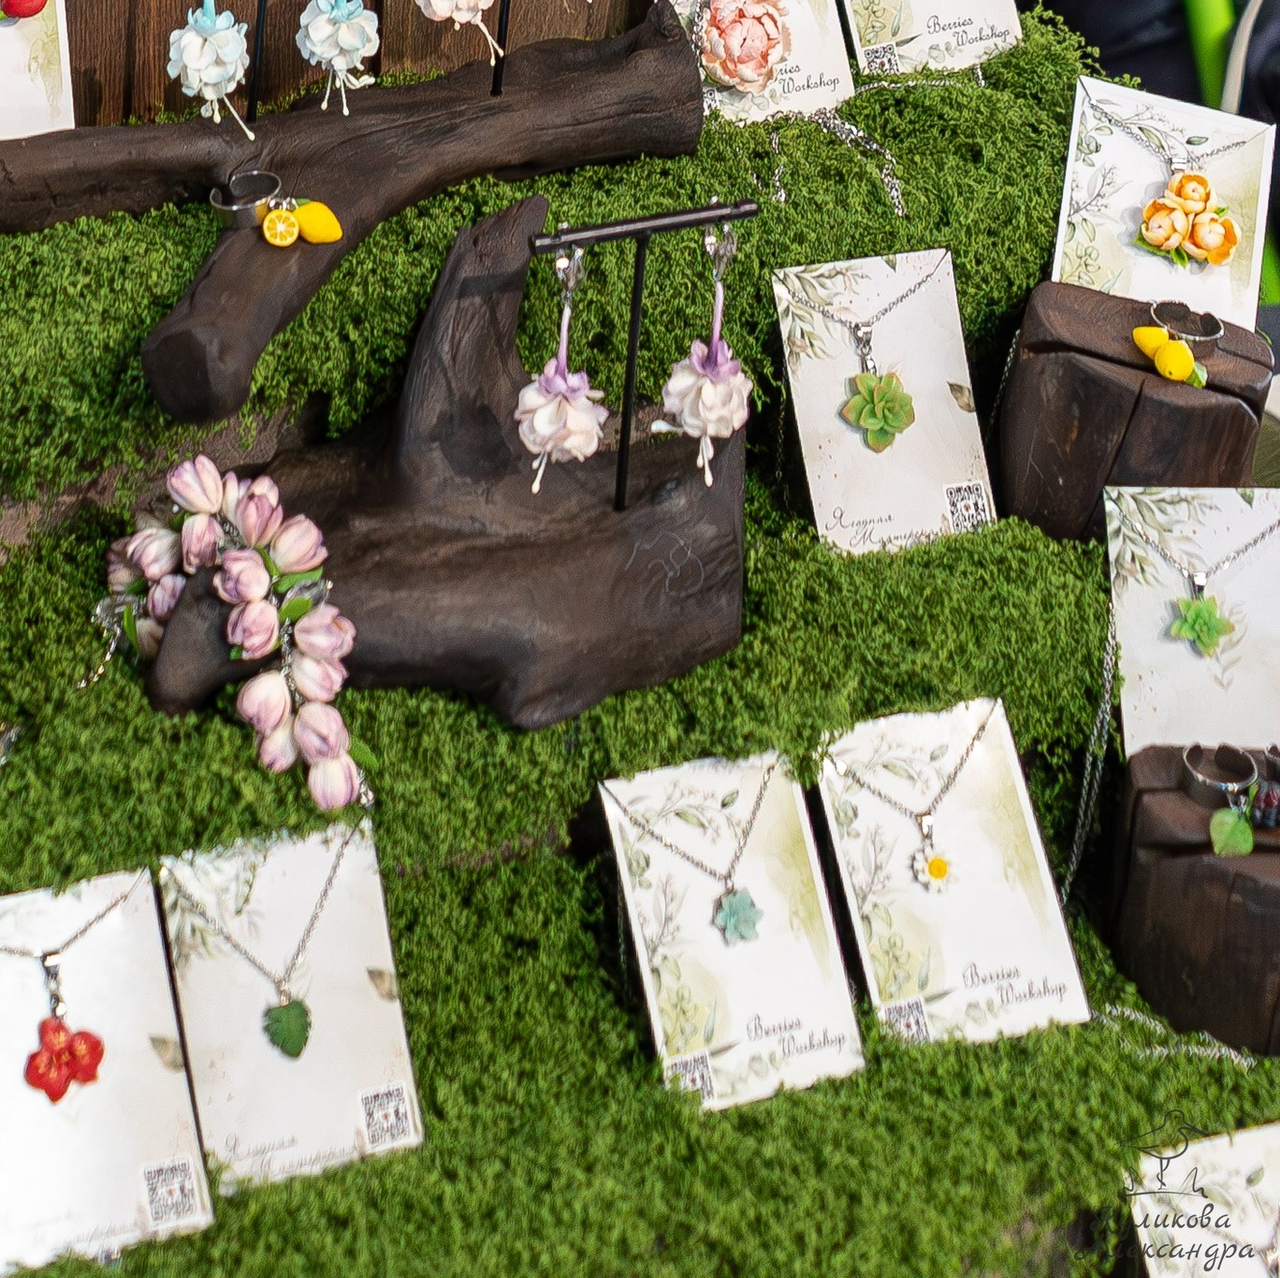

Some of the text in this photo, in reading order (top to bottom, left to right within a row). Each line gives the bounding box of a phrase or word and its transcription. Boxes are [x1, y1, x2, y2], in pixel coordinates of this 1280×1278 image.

[926, 15, 974, 34] Berries
[952, 25, 1010, 47] Workshop
[779, 73, 840, 94] Workshop
